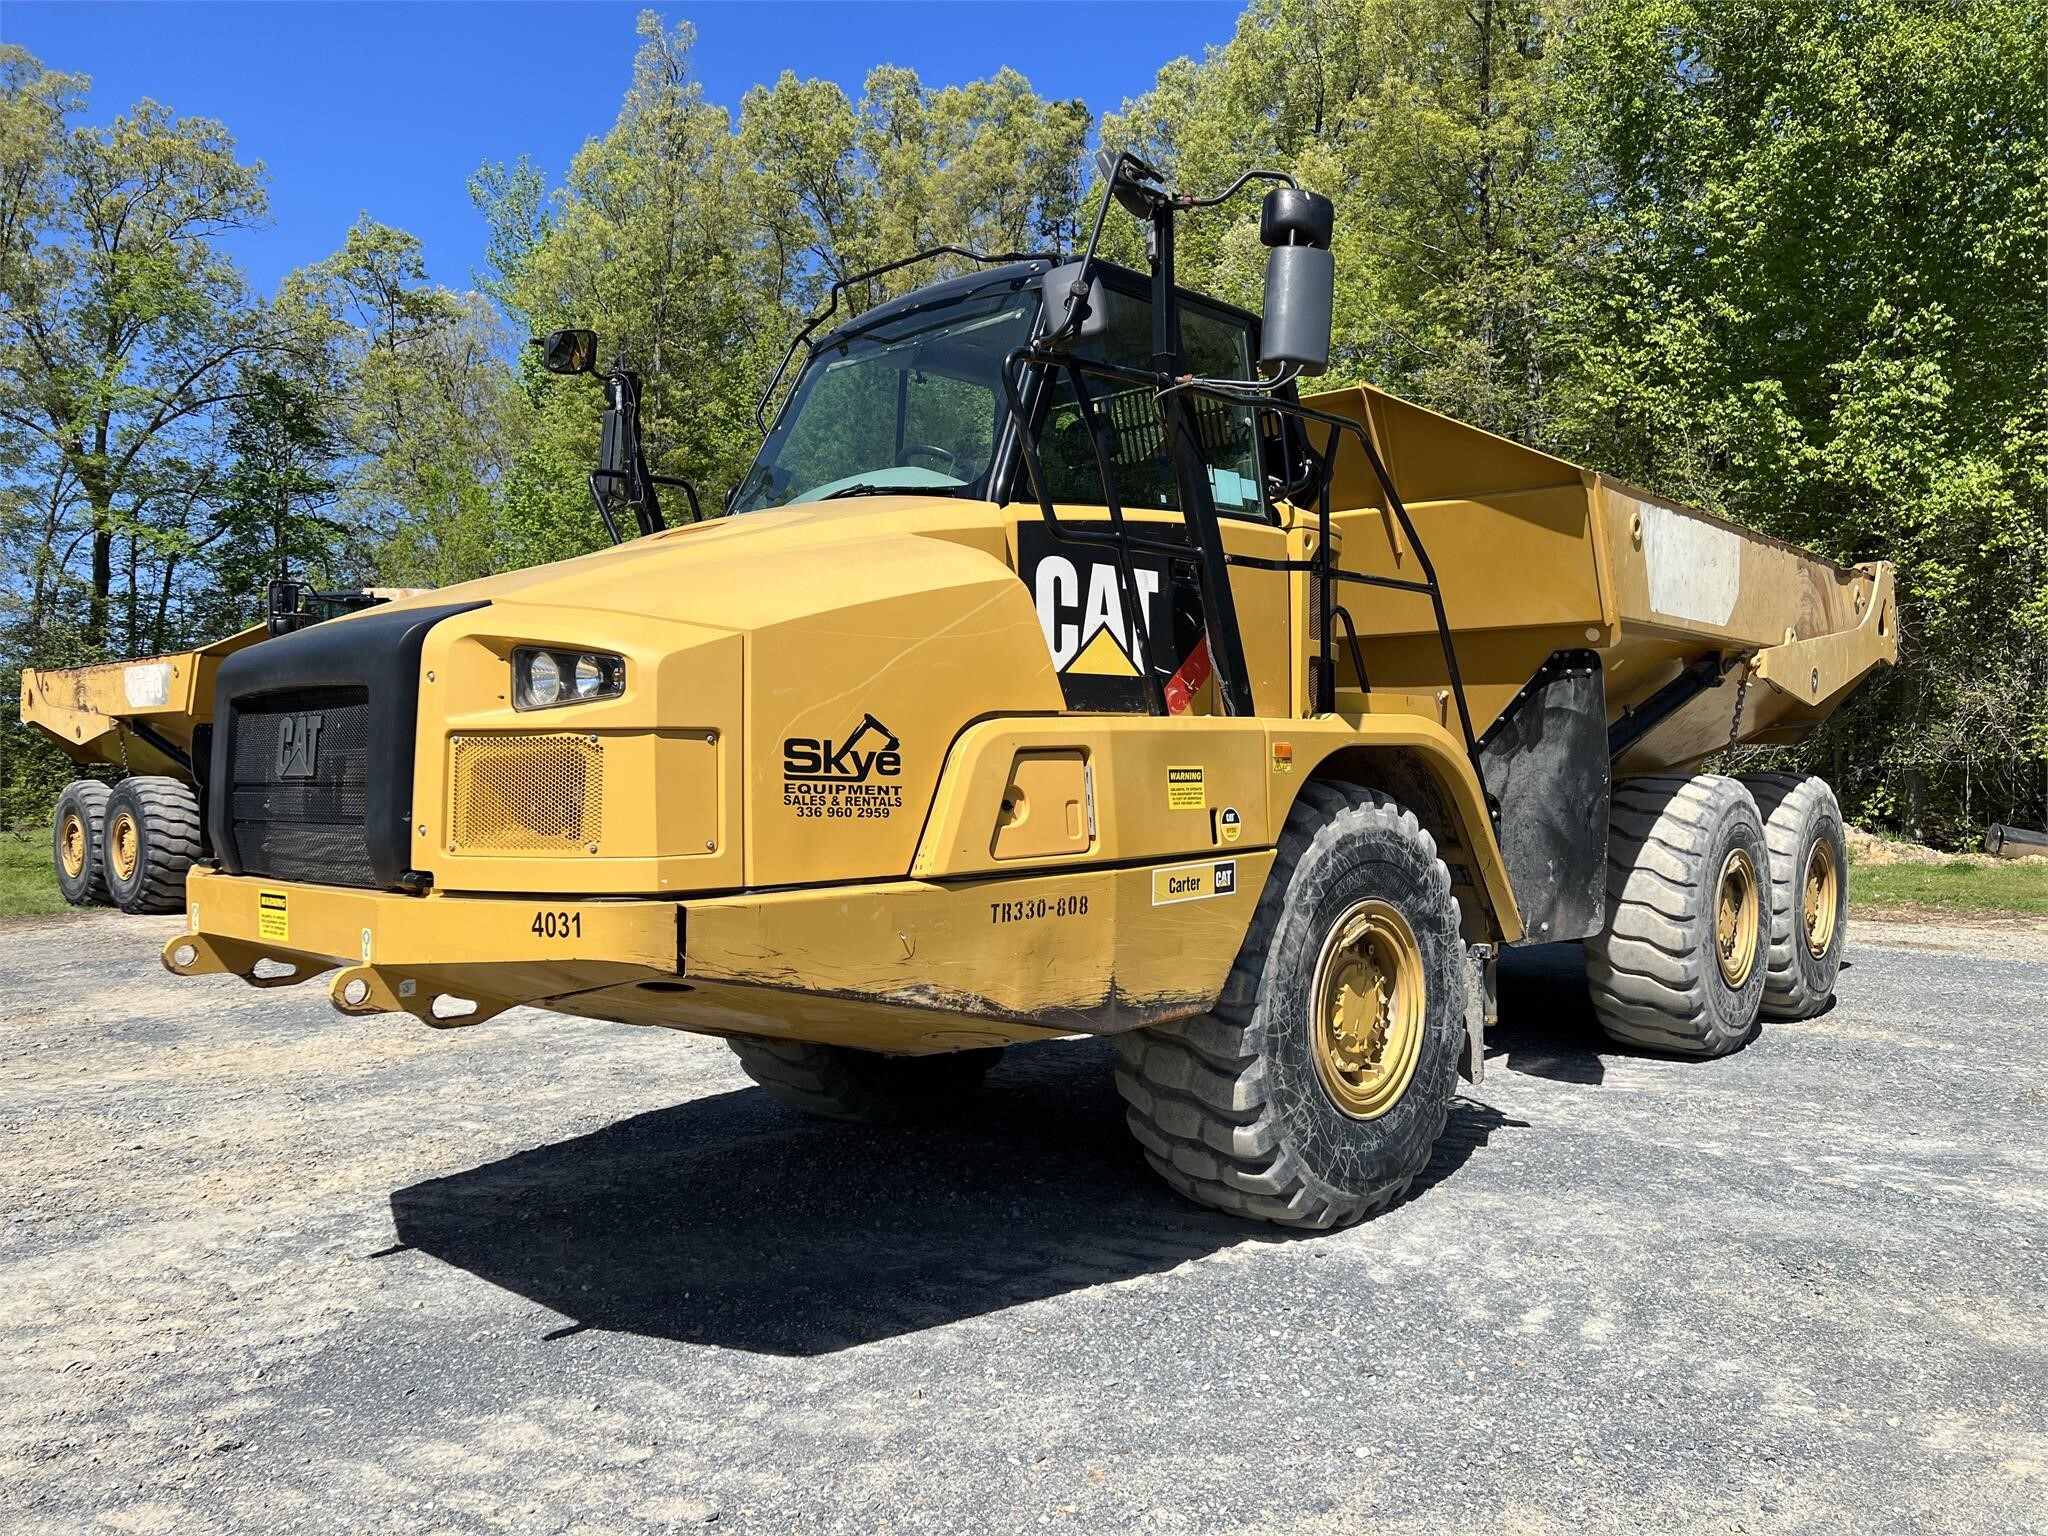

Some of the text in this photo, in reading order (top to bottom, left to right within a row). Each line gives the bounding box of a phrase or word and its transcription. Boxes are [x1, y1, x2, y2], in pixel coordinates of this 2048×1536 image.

[1035, 555, 1159, 676] CAT
[276, 715, 323, 779] CAT
[1170, 771, 1202, 781] WARNING
[783, 795, 902, 808] SALES & RENTALS
[784, 783, 903, 796] EQUIPMENT
[796, 806, 890, 818] 336 960 2959
[1169, 869, 1233, 894] Carter CAT
[990, 895, 1089, 924] TR330-808
[531, 912, 581, 938] 4031
